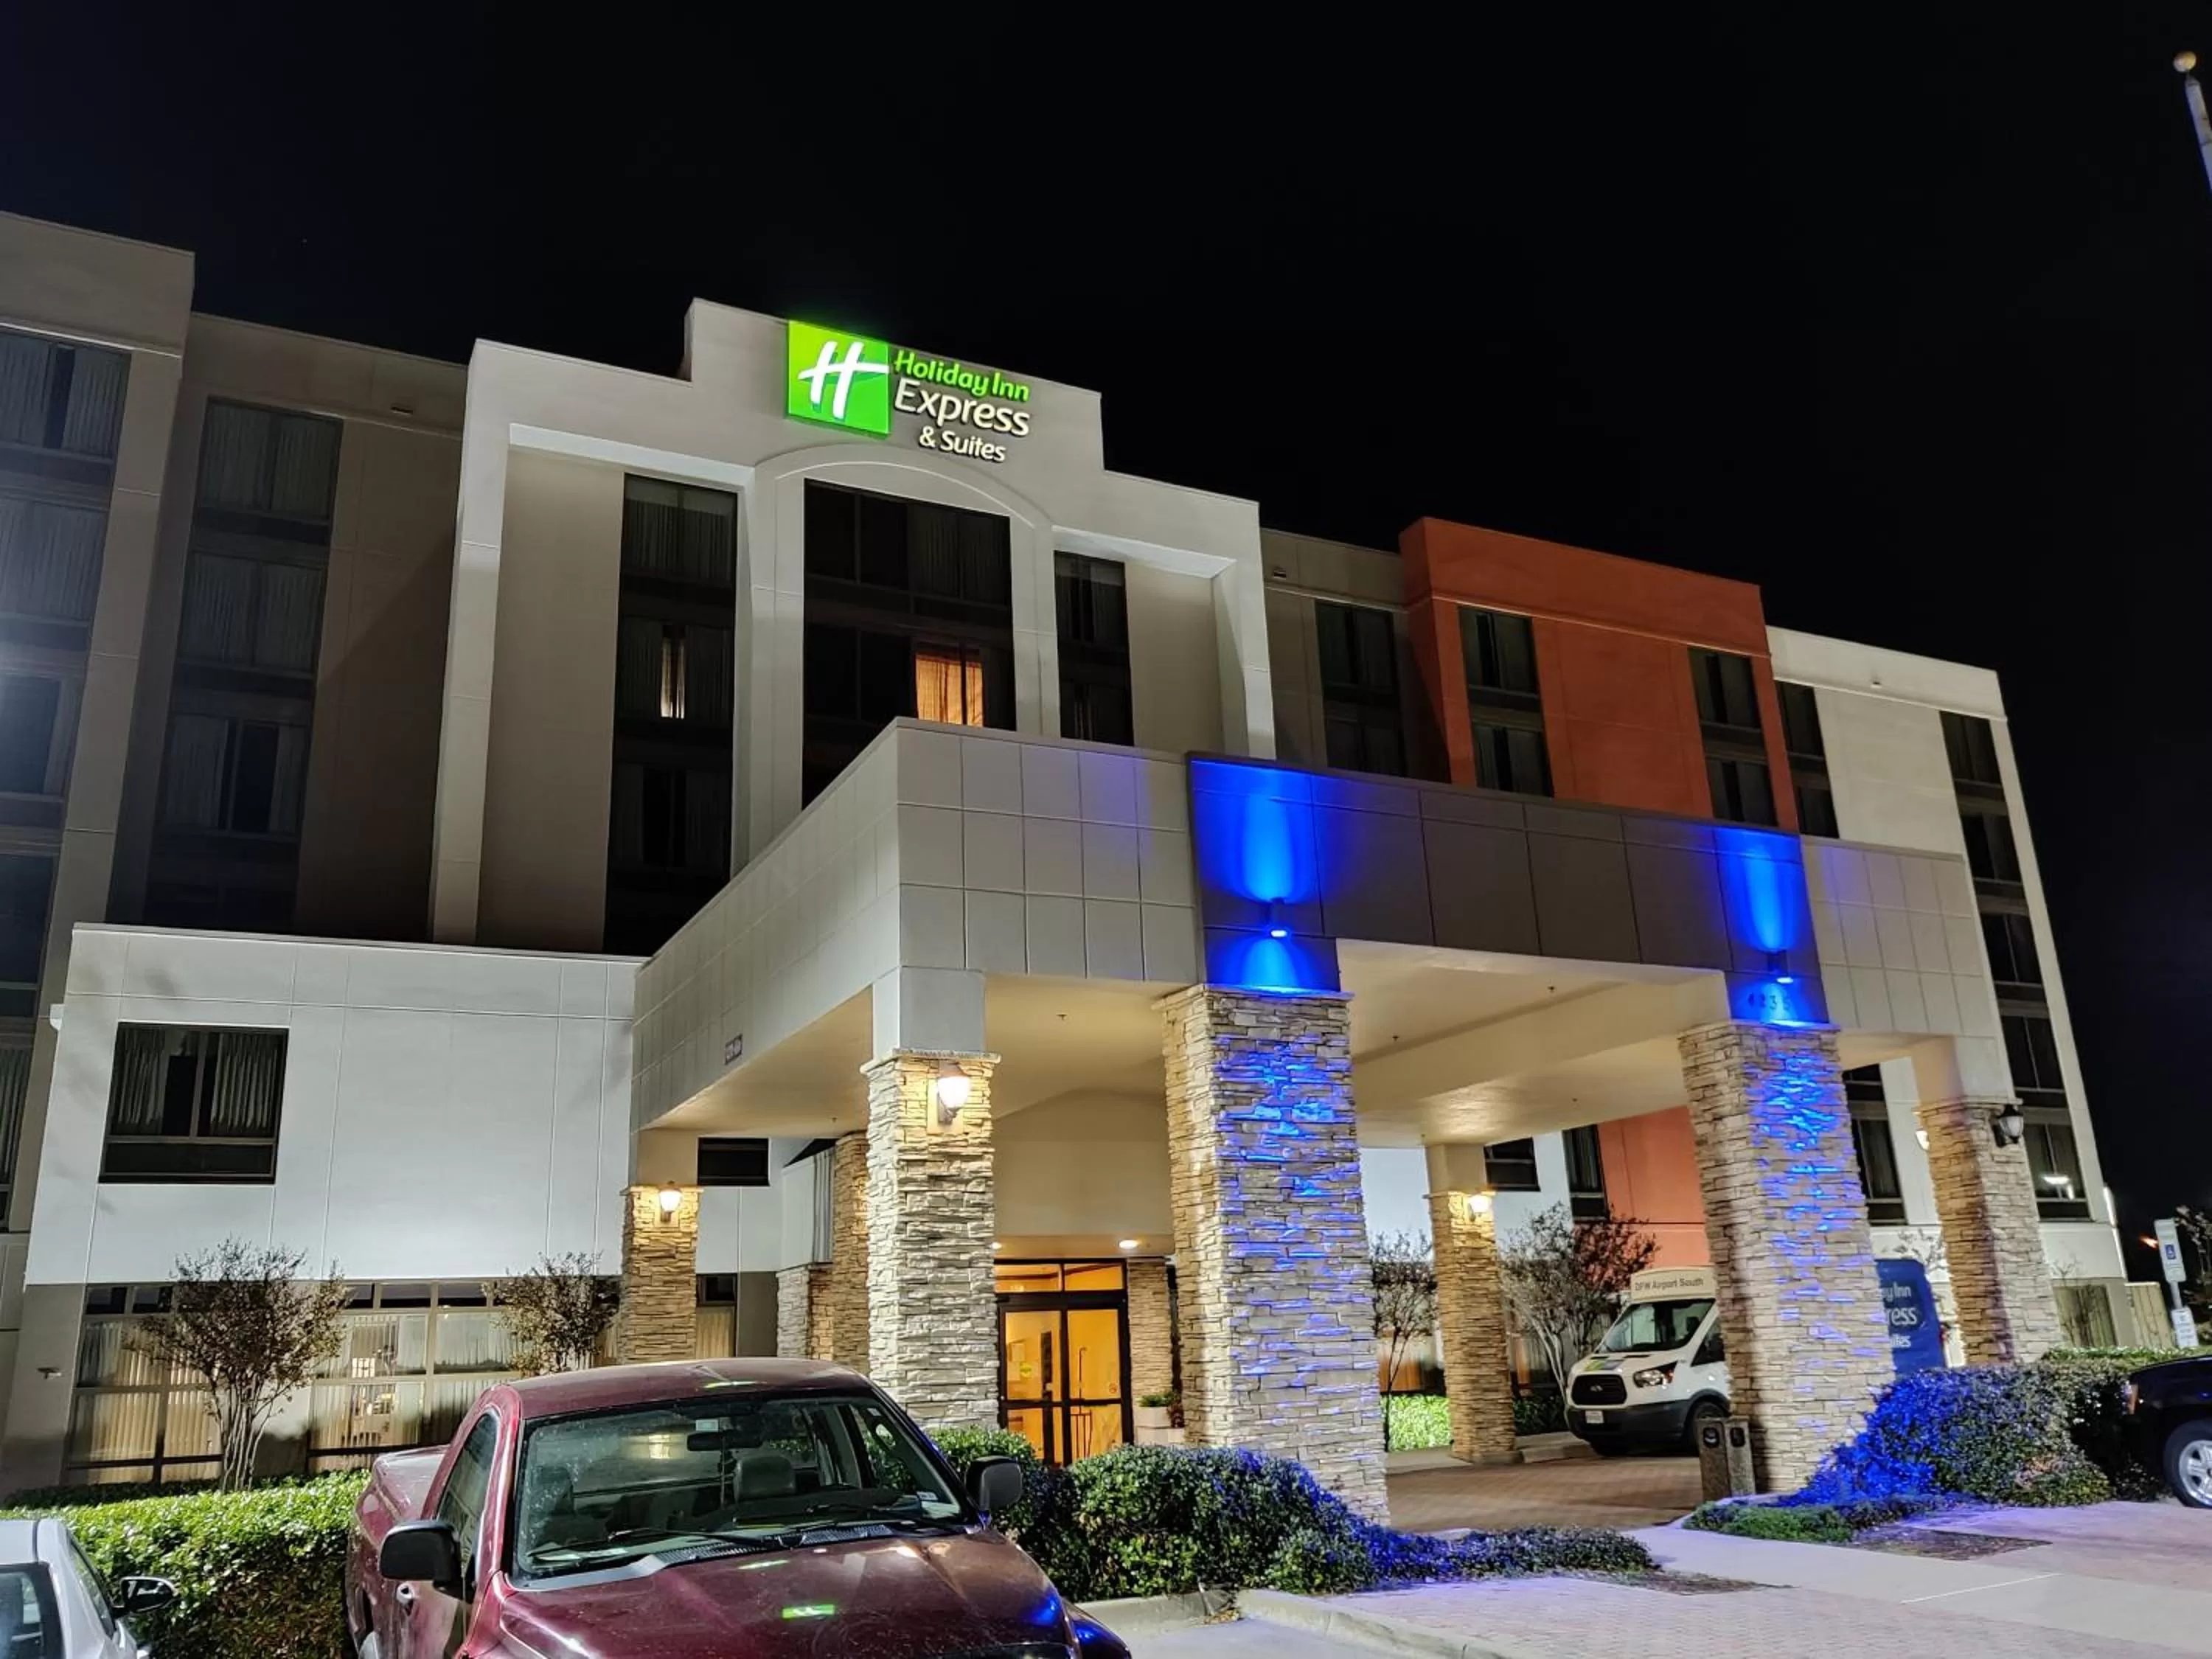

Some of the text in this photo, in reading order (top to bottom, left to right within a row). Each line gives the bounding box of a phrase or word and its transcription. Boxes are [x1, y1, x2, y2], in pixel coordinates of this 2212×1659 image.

[894, 349, 1030, 402] Holiday Inn
[894, 377, 1031, 437] Express
[919, 425, 1006, 463] & Suites
[1652, 1279, 1677, 1291] Airport
[1678, 1276, 1704, 1287] South
[1893, 1281, 1912, 1298] Inn
[1885, 1307, 1918, 1326] ress
[1891, 1333, 1912, 1349] ites
